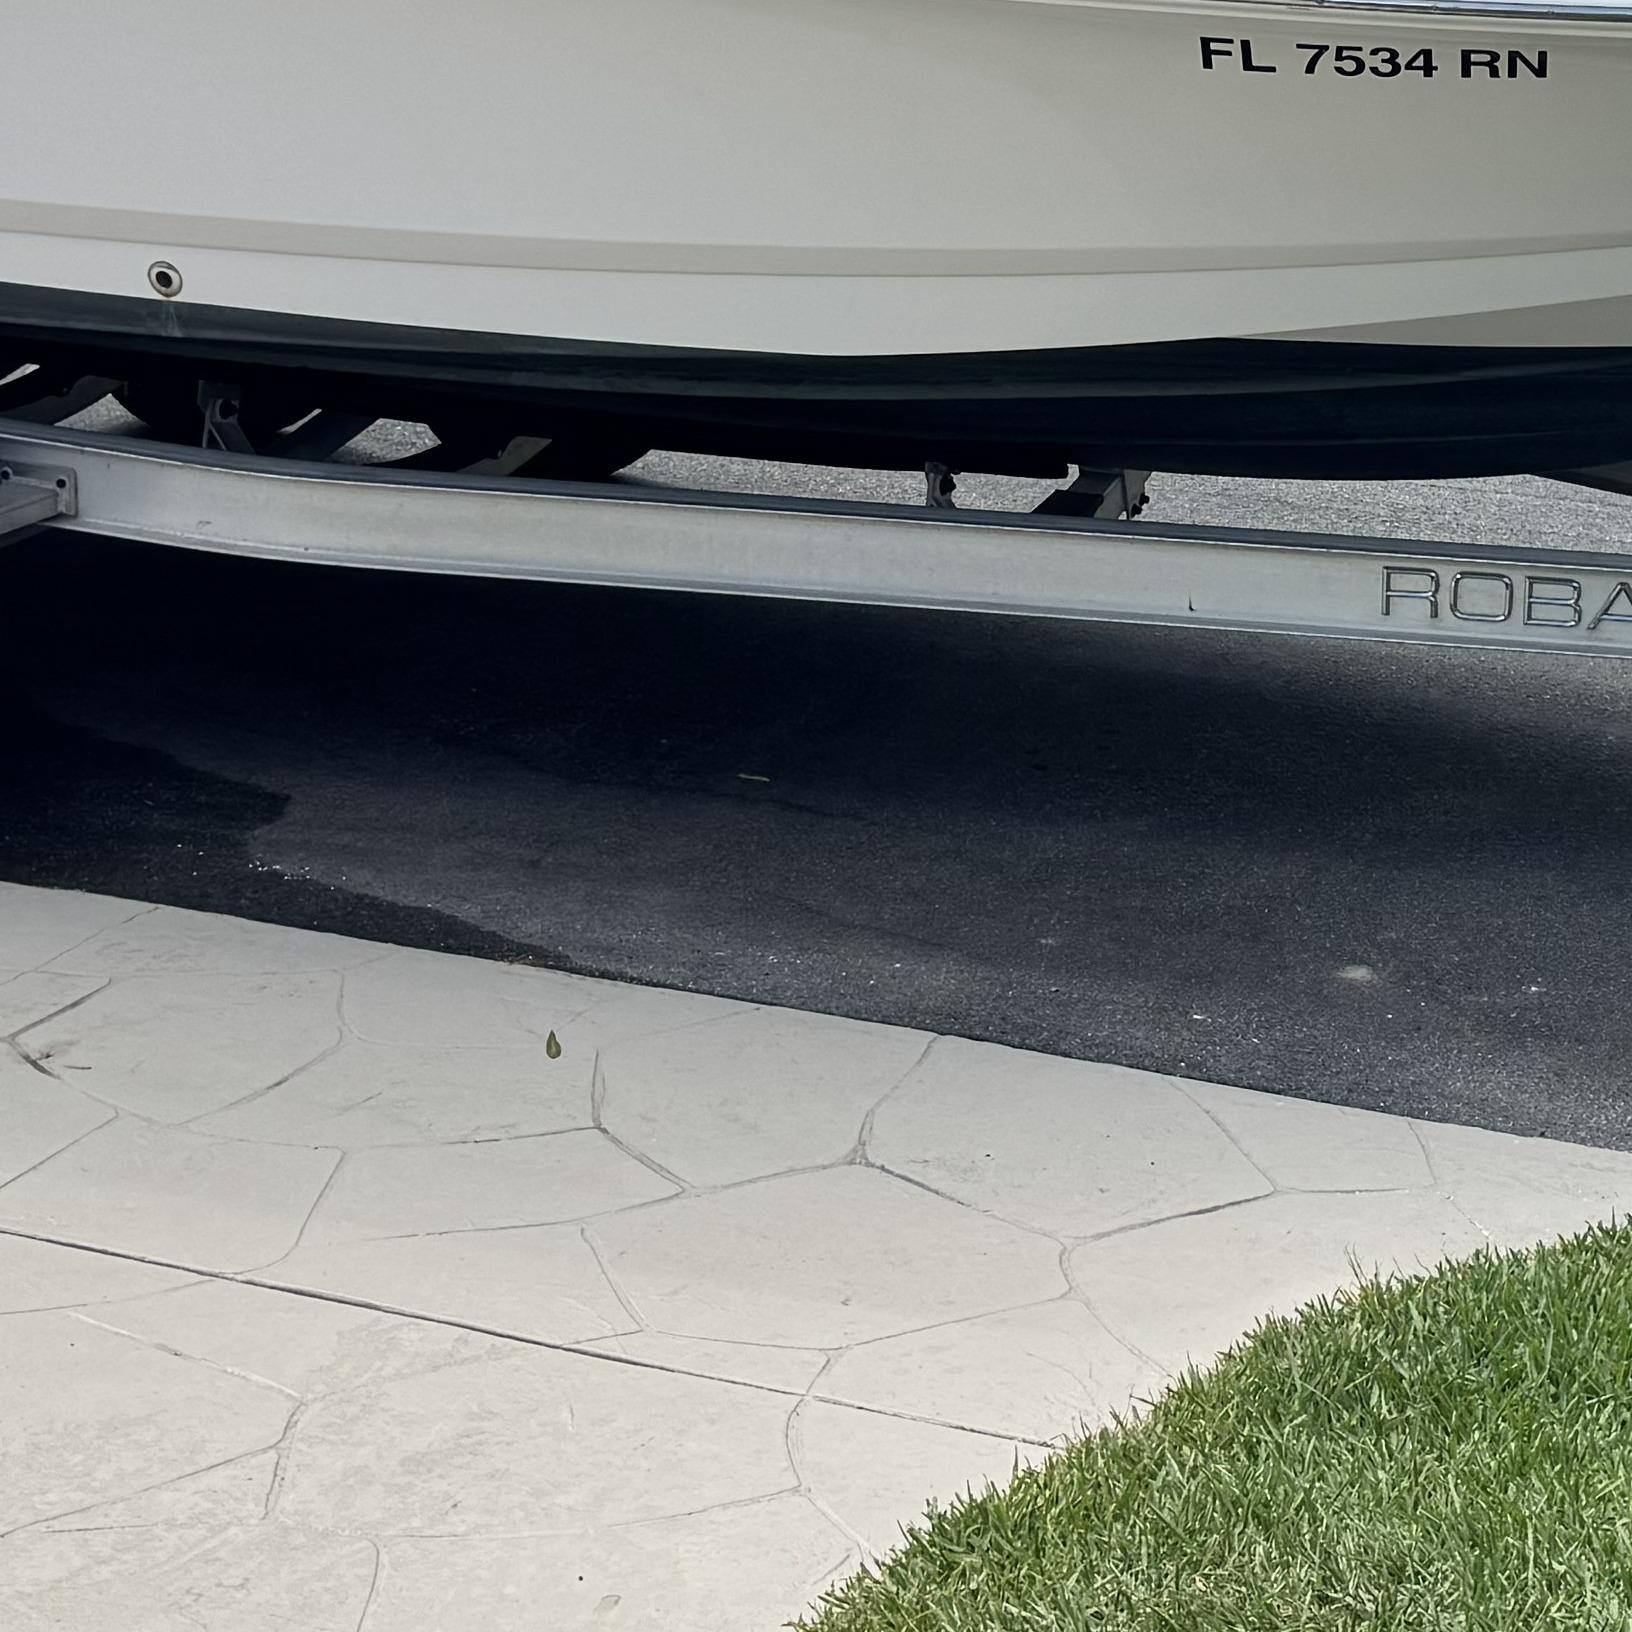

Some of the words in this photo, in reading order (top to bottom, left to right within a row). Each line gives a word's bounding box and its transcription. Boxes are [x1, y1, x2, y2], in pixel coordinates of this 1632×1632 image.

[1199, 36, 1277, 73] FL
[1295, 43, 1438, 78] 7534
[1460, 49, 1548, 78] RN
